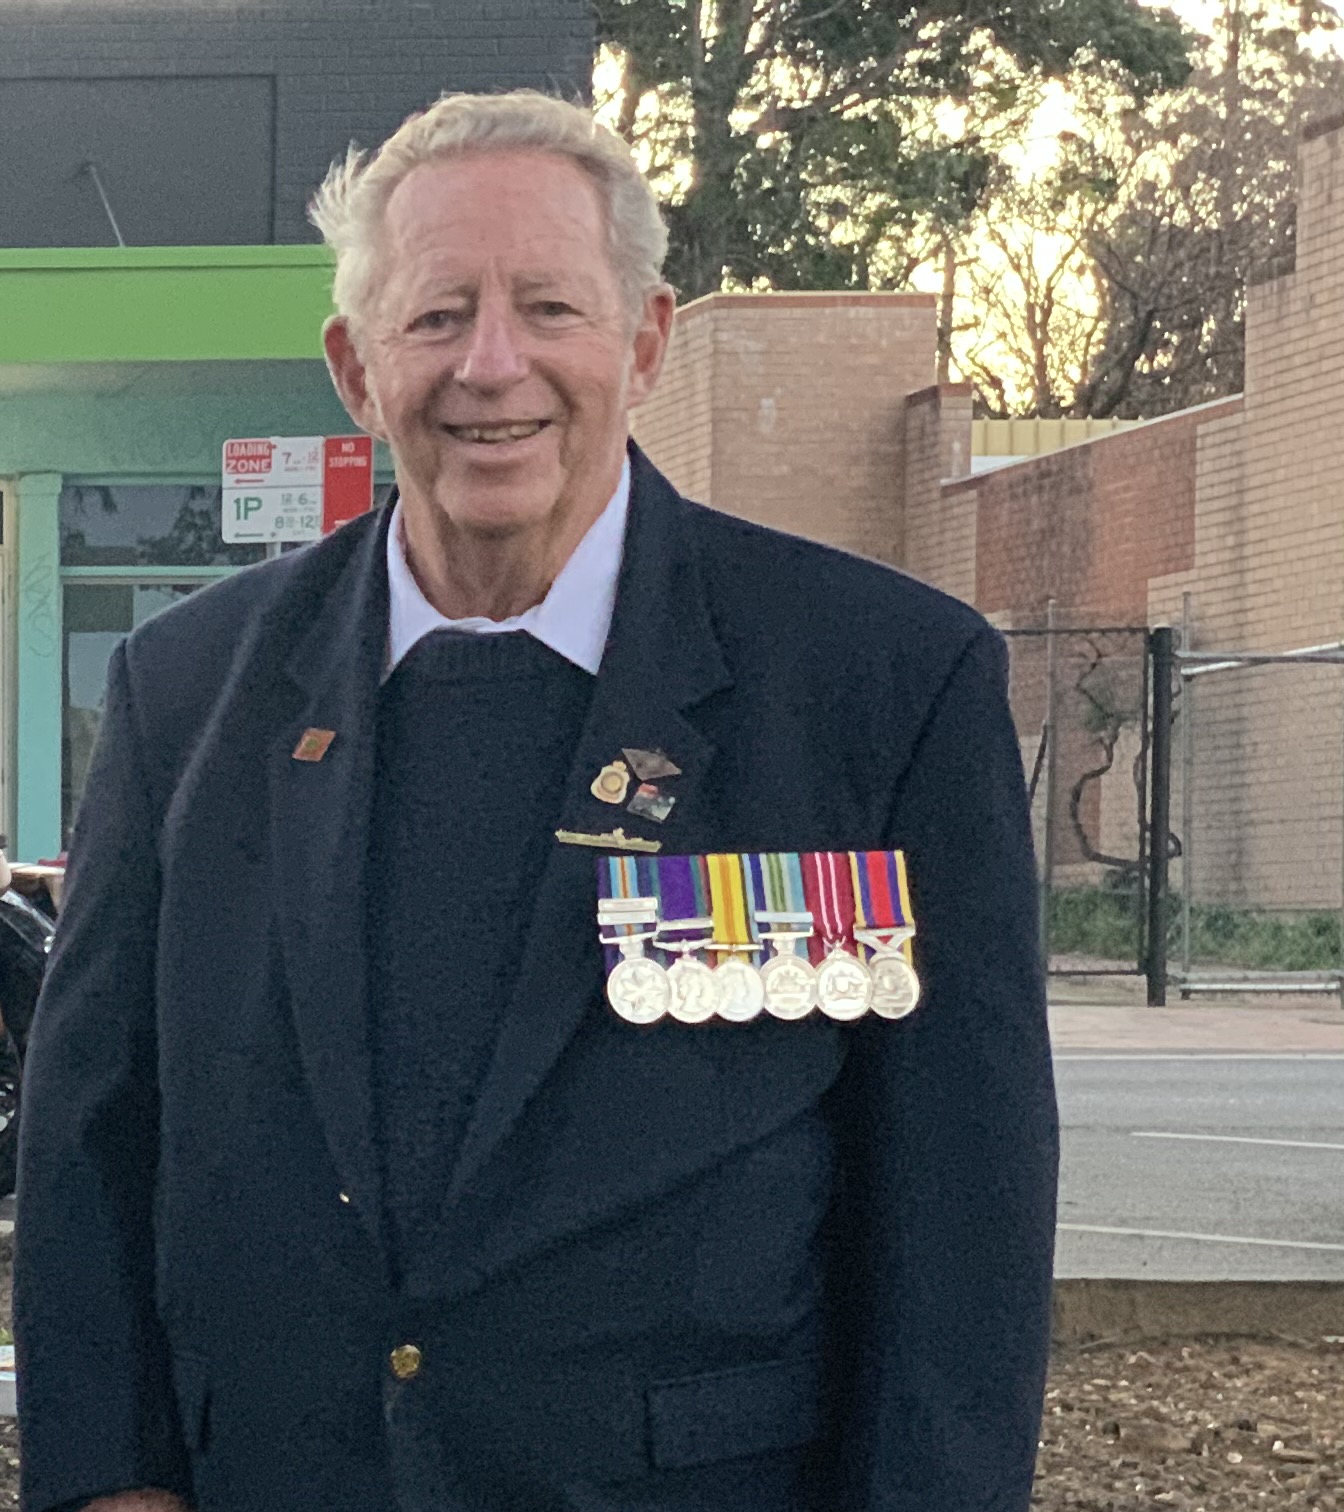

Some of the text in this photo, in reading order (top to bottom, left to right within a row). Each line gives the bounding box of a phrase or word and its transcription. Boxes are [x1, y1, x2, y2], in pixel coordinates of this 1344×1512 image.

[227, 442, 270, 457] LOADING
[341, 442, 355, 453] NO
[226, 459, 271, 473] ZONE
[328, 456, 368, 468] STOPPING
[233, 496, 263, 521] 1P
